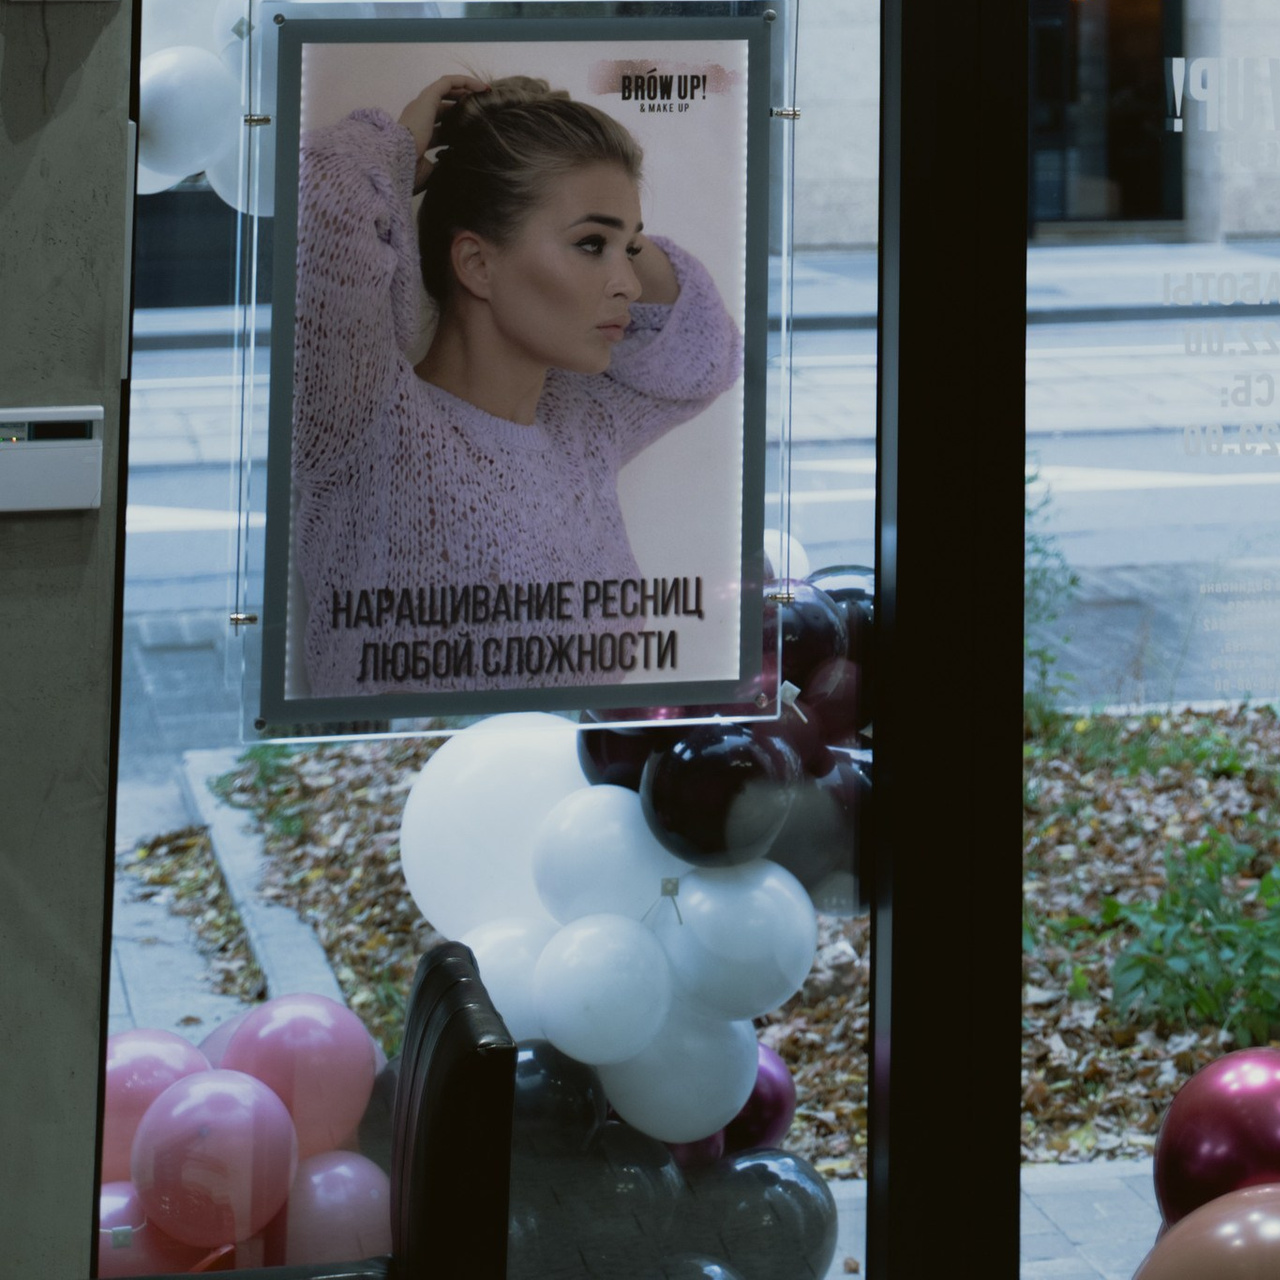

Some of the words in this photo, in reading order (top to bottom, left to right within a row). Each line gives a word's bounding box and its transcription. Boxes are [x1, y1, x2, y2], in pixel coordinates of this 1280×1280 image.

[621, 67, 673, 101] BRÓW
[677, 74, 707, 100] UP!
[639, 103, 646, 113] &
[648, 103, 674, 113] MAKE
[678, 103, 690, 113] UP
[331, 580, 573, 629] НАРАЩИВАНИЕ
[583, 576, 704, 620] РЕСНИЦ
[357, 632, 473, 683] ЛЮБОЙ
[482, 630, 677, 677] СЛОЖНОСТИ
